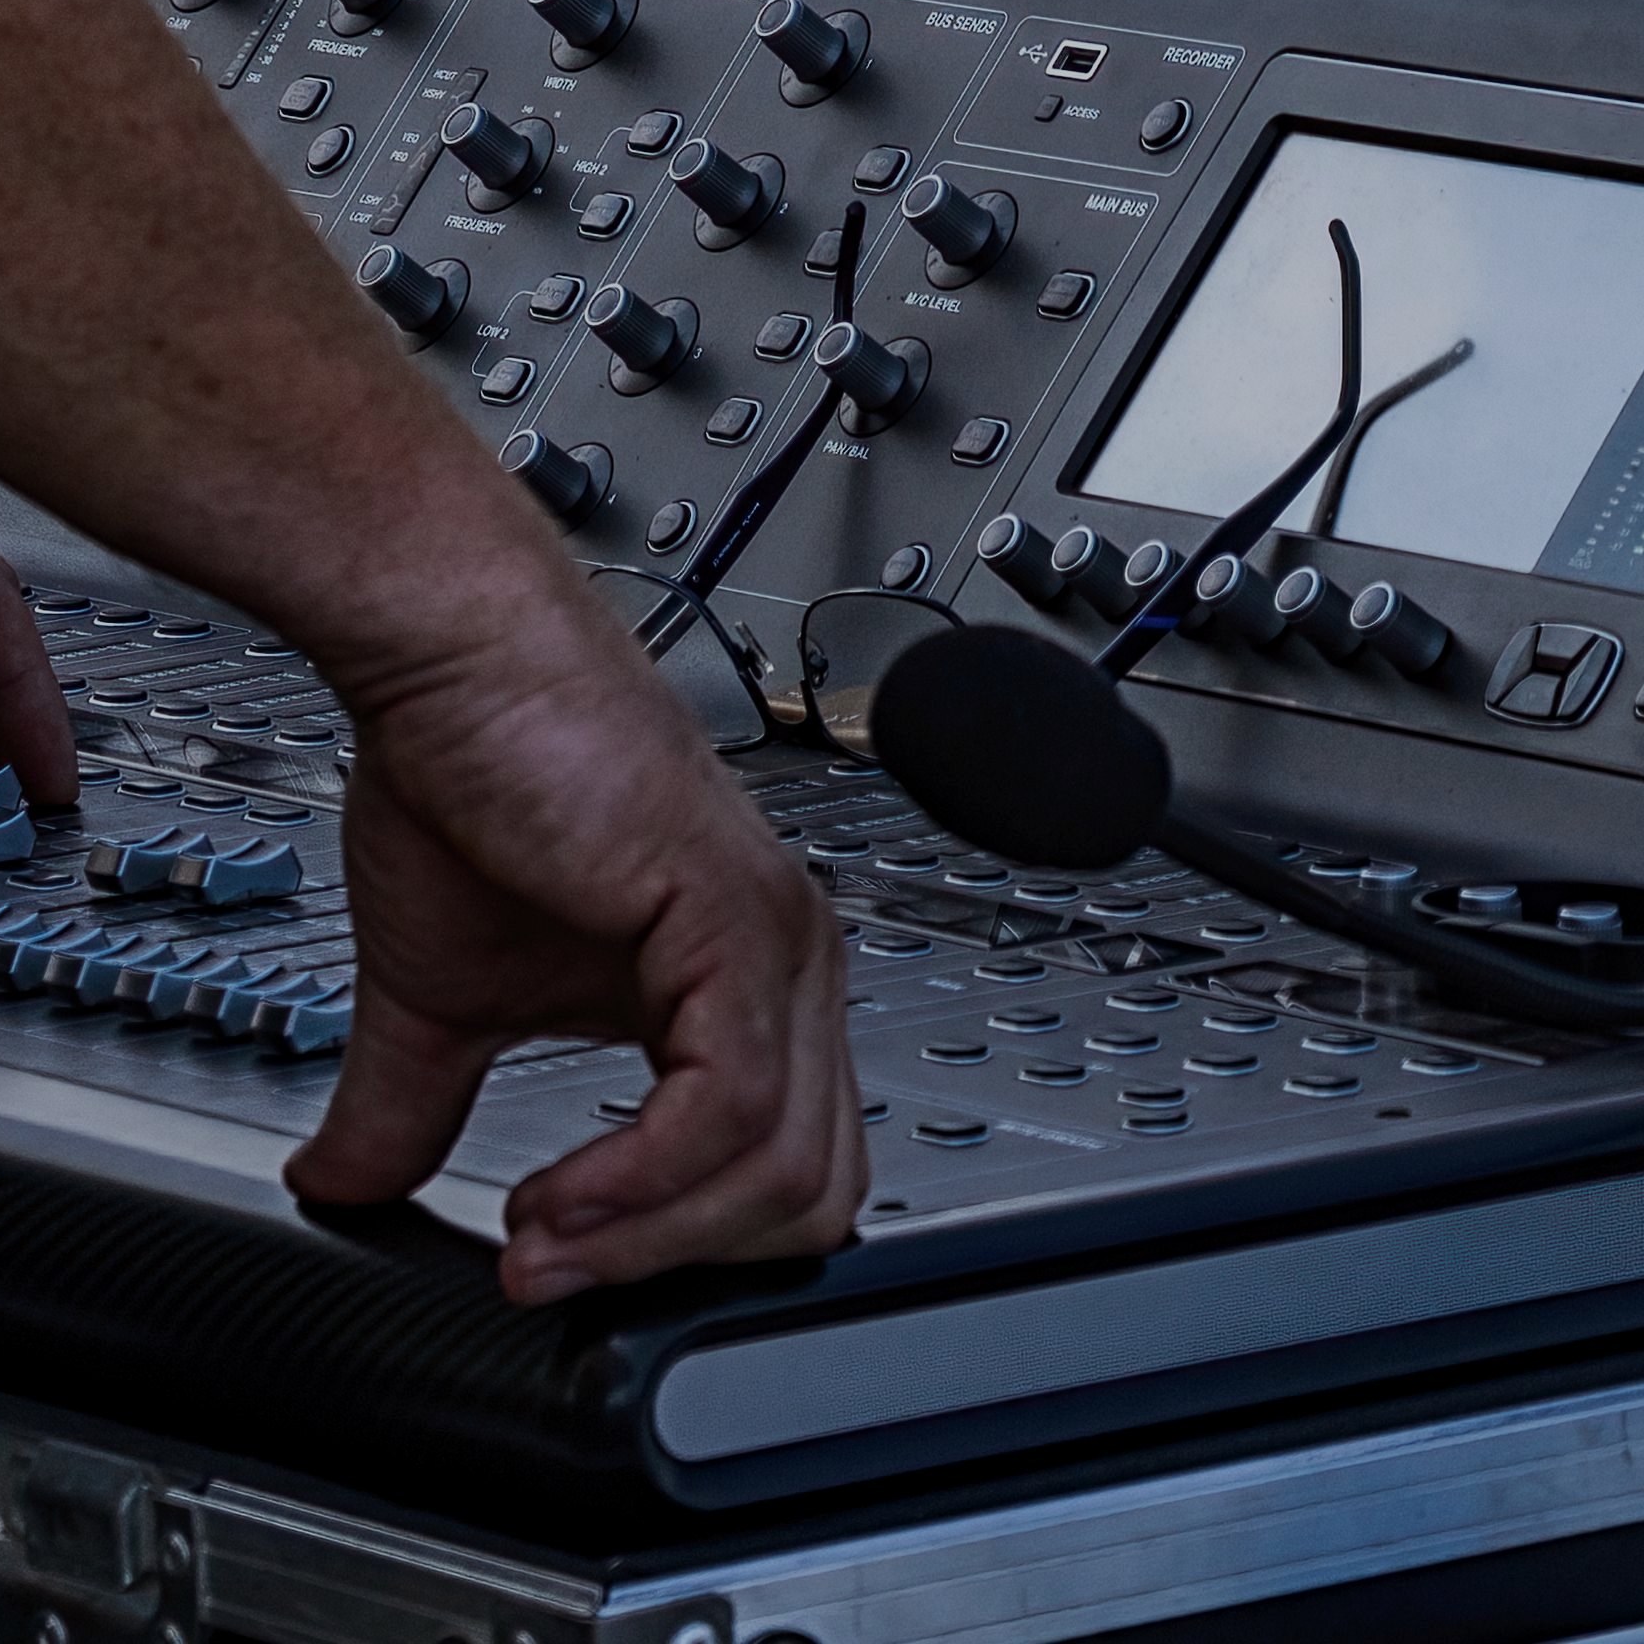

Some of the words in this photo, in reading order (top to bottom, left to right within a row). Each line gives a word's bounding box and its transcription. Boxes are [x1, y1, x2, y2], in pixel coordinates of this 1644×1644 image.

[165, 16, 191, 30] GAIN
[925, 11, 954, 29] BUS
[953, 15, 998, 35] SENDS
[307, 38, 368, 58] FREQUENCY
[1162, 46, 1236, 71] RECORDER
[543, 75, 578, 92] WIDTH
[1062, 105, 1101, 120] ACCESS
[572, 159, 600, 175] HIGH
[1084, 194, 1120, 213] MAIN
[1119, 200, 1149, 218] BUS
[444, 214, 506, 236] FREQUENCY
[904, 291, 929, 308] M/C
[928, 294, 961, 313] LEVEL
[476, 324, 499, 339] LOW
[822, 440, 870, 460] PAN/BAL
